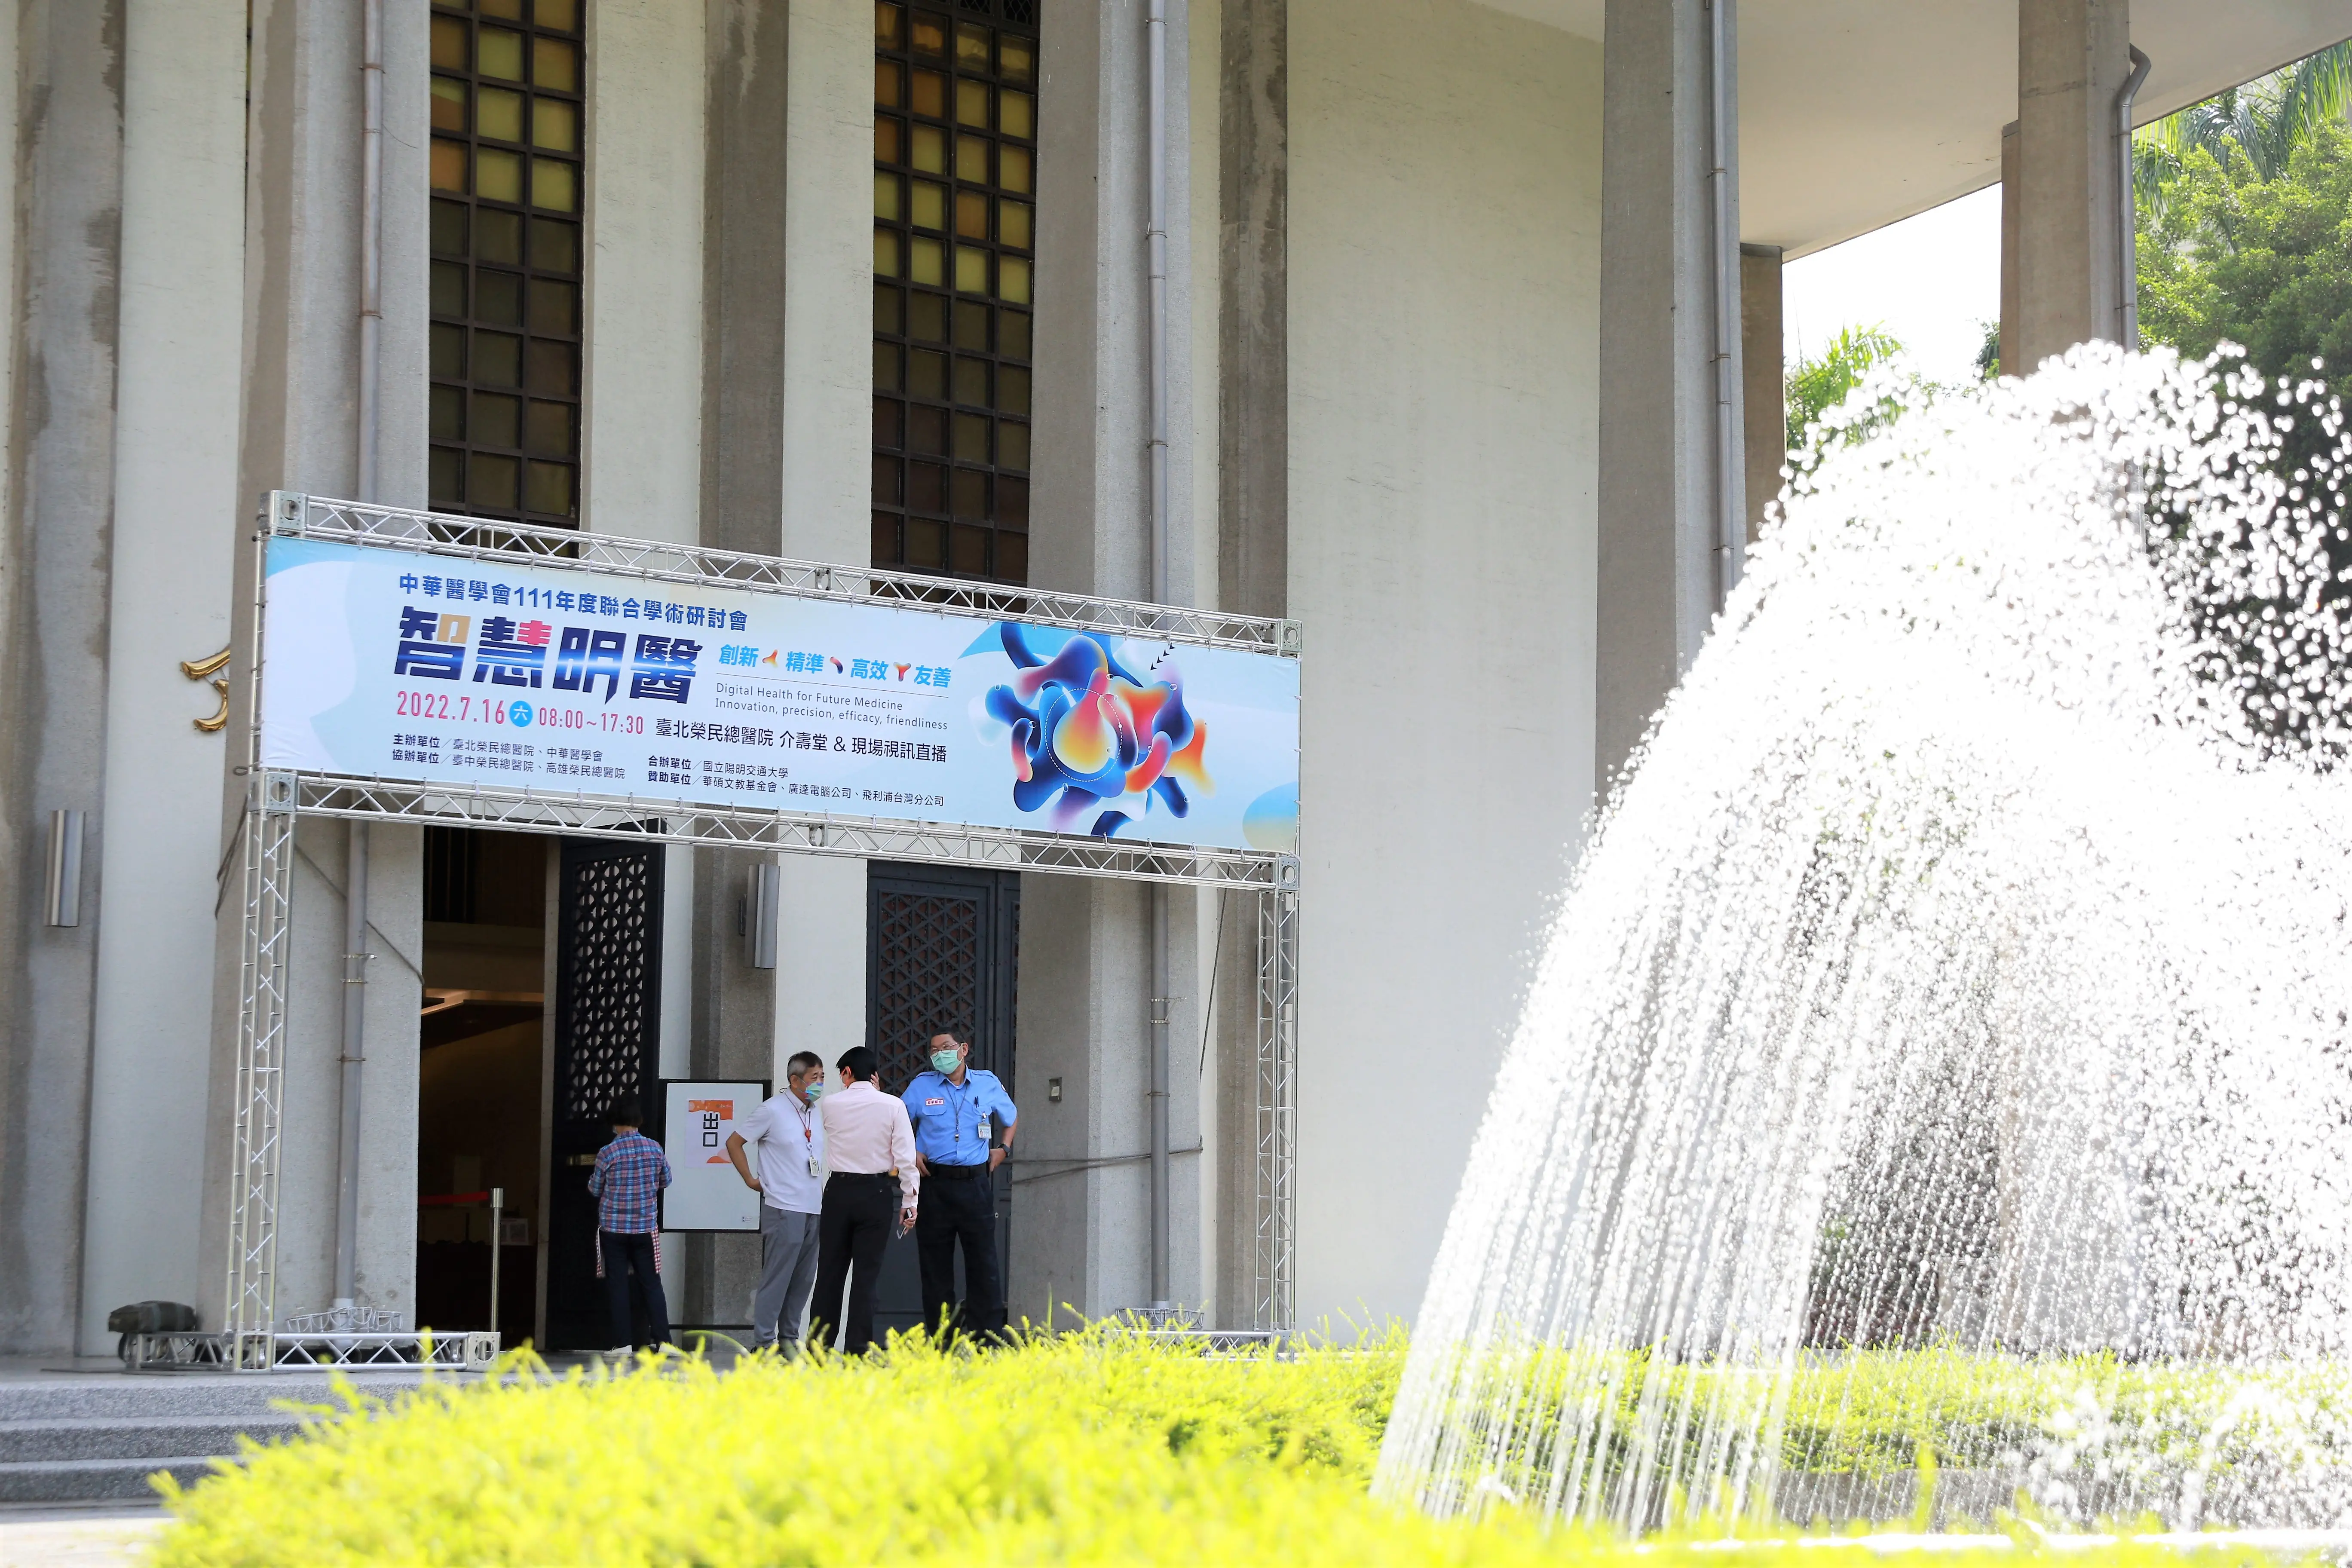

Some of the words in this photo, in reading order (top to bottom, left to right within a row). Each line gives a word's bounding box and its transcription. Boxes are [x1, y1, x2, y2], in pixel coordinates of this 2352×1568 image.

[399, 573, 747, 631] 中華醫學會111年度聯合學術研討會
[394, 606, 703, 704] 智慧明醫
[719, 644, 759, 668] 創新
[785, 651, 824, 674] 精準
[850, 658, 889, 681] 高效
[914, 665, 951, 688] 友善
[397, 690, 505, 725] 2022.7.16
[514, 705, 529, 722] 六
[715, 698, 778, 715] Innovation,
[782, 706, 835, 720] precision,
[839, 711, 882, 725] efficacy,
[886, 716, 948, 730] friendliness
[717, 683, 753, 696] Digital
[757, 687, 793, 700] Health
[797, 691, 812, 701] for
[816, 693, 851, 705] Future
[854, 697, 903, 710] Medicine
[655, 718, 774, 747] 臺北榮民總醫院
[779, 730, 828, 752] 介壽堂
[834, 737, 846, 752] &
[851, 737, 947, 763] 現場視訊直播
[703, 1113, 719, 1147] 出口
